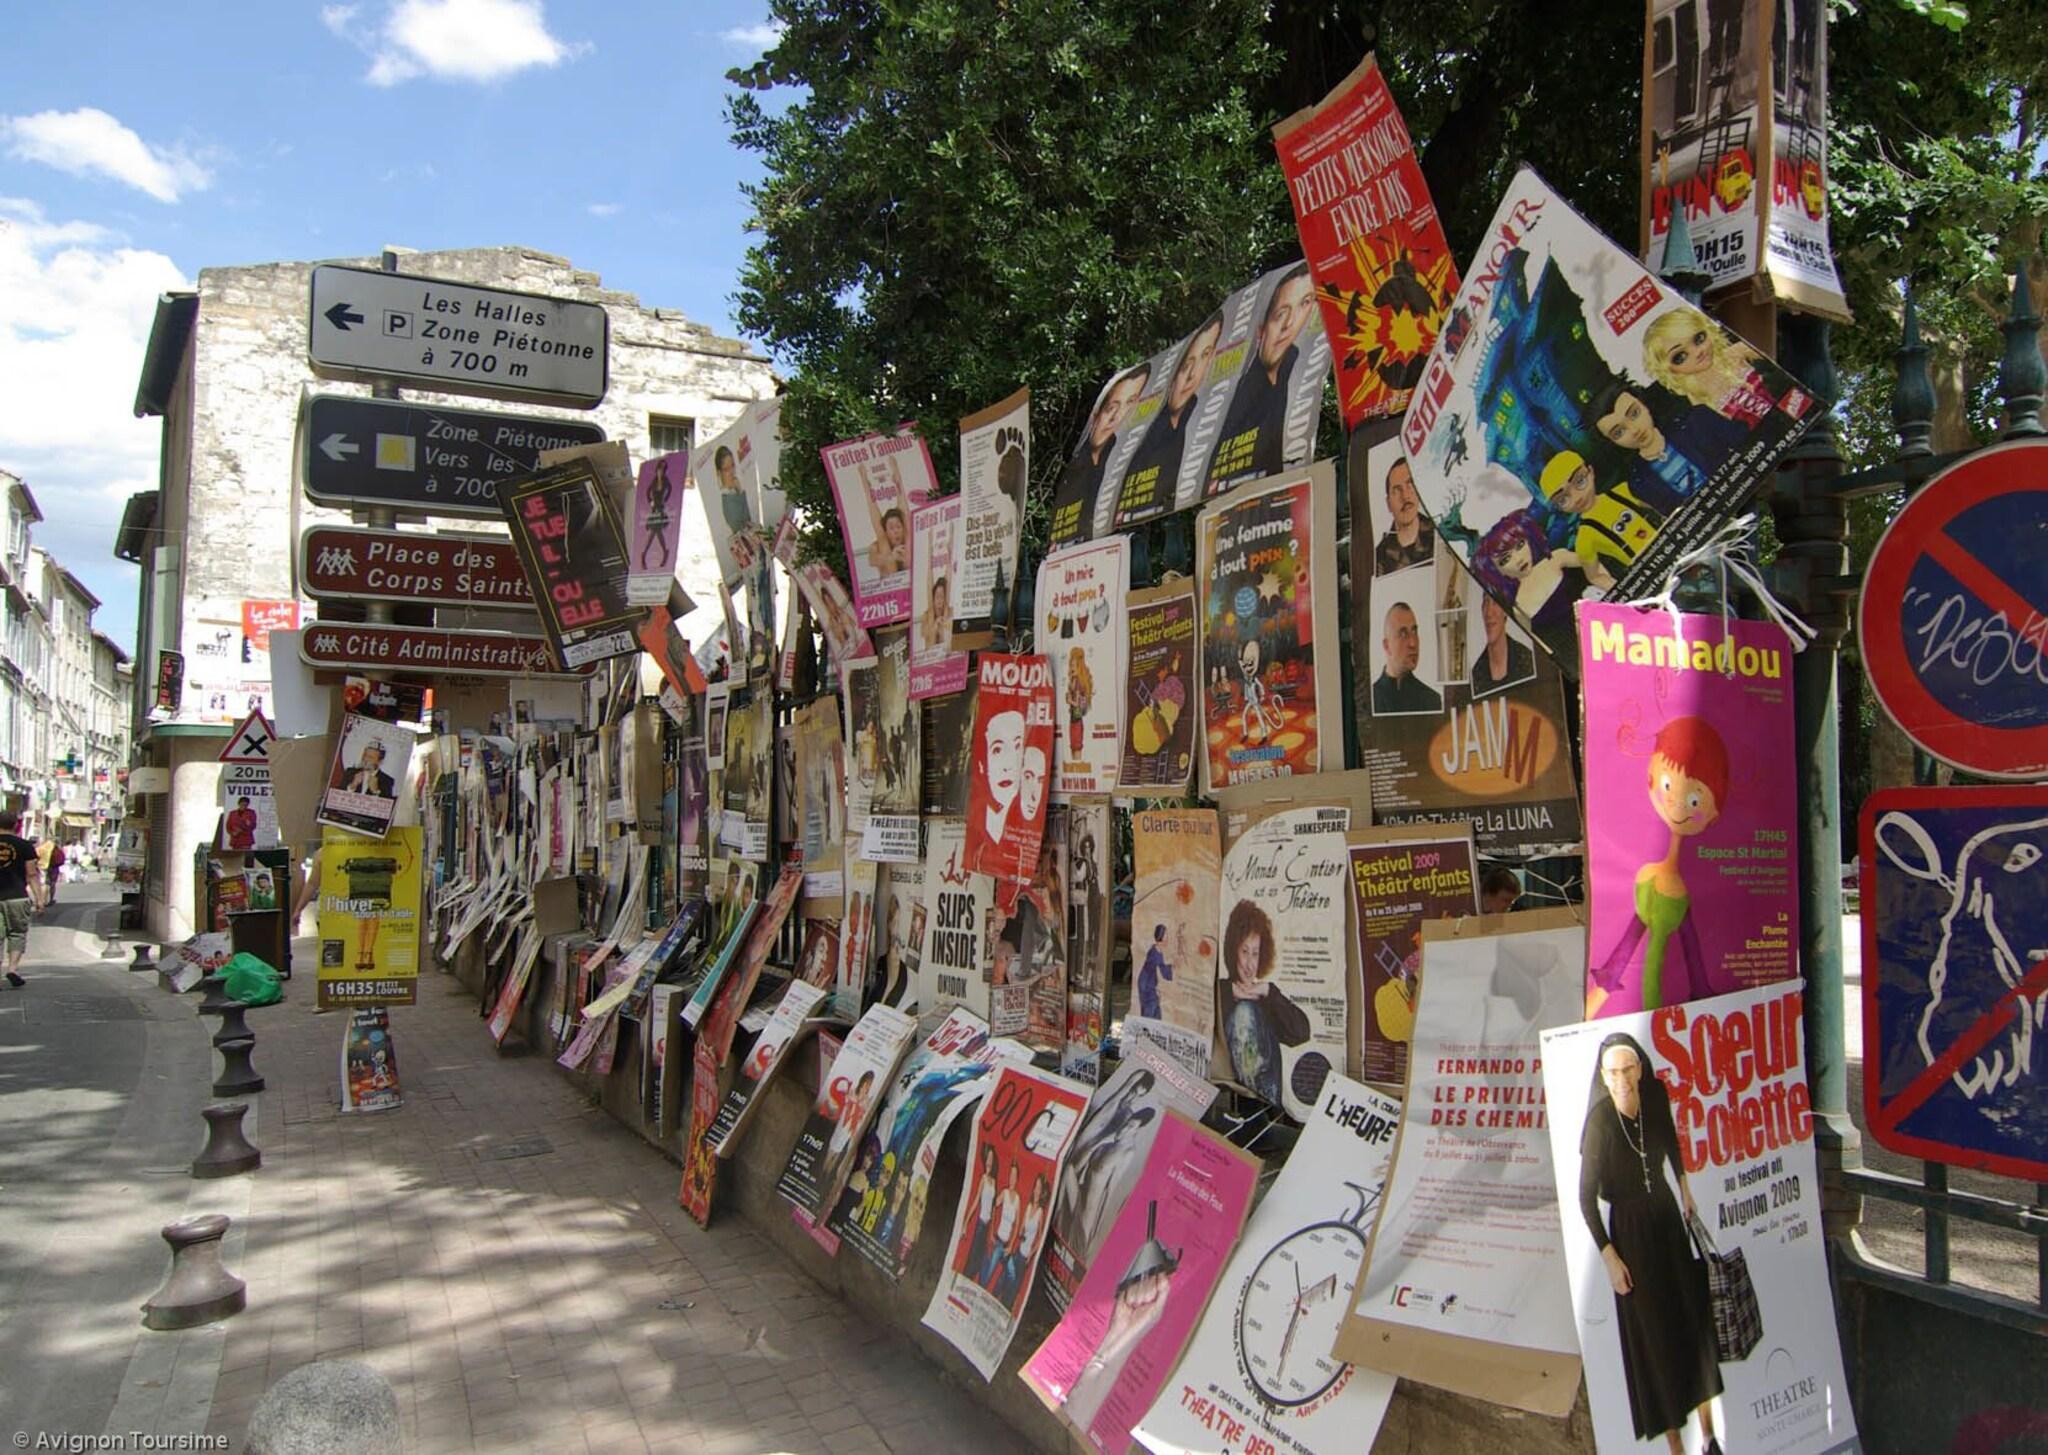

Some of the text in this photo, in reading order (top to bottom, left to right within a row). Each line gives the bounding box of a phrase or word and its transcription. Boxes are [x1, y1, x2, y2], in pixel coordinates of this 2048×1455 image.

[1293, 155, 1347, 217] PETITS
[1329, 186, 1382, 248] ENTRE
[1376, 169, 1413, 232] AMIS
[423, 292, 469, 316] Les
[475, 301, 546, 326] Halles
[422, 320, 595, 360] Zone Piétonne
[422, 348, 528, 378] à 700 m
[427, 419, 479, 443] Zone
[425, 447, 468, 469] Vers
[487, 452, 515, 473] les
[831, 435, 914, 470] Faites l'amour
[425, 474, 438, 493] à
[1665, 543, 1676, 555] du
[1706, 497, 1717, 509] au
[1744, 440, 1765, 463] 2009
[524, 495, 547, 518] JE
[529, 515, 566, 540] TUE
[1236, 516, 1294, 545] femme
[368, 542, 496, 568] Place des
[1221, 553, 1248, 575] tout
[1288, 538, 1299, 558] ?
[367, 568, 443, 593] Corps
[553, 580, 583, 602] OU
[560, 598, 605, 625] ELLE
[861, 600, 899, 622] 22h15
[347, 631, 389, 656] Cité
[398, 640, 546, 667] Administrative
[1590, 620, 1781, 679] Mamadou
[1293, 820, 1346, 835] SHAKESPEARE
[1487, 806, 1554, 832] La LUNA
[1354, 851, 1441, 878] Festival 2009
[1697, 846, 1787, 861] Espace St Martial
[1357, 867, 1470, 899] Théâtr'enfants
[937, 891, 975, 931] SLIPS
[1778, 912, 1788, 921] La
[931, 930, 977, 971] INSIDE
[328, 981, 373, 995] 16H35
[1437, 1058, 1525, 1074] FERNANDO
[1434, 1086, 1456, 1103] LE
[1324, 1093, 1399, 1146] L'HEURE
[1430, 1108, 1546, 1129] DES CHEMI
[1676, 1080, 1815, 1175] Colette
[1725, 1177, 1737, 1192] au
[1738, 1162, 1769, 1188] festival
[1719, 1175, 1801, 1229] Avignon 2009
[1750, 1376, 1818, 1419] THEATRE
[1180, 1385, 1246, 1443] THEATRE
